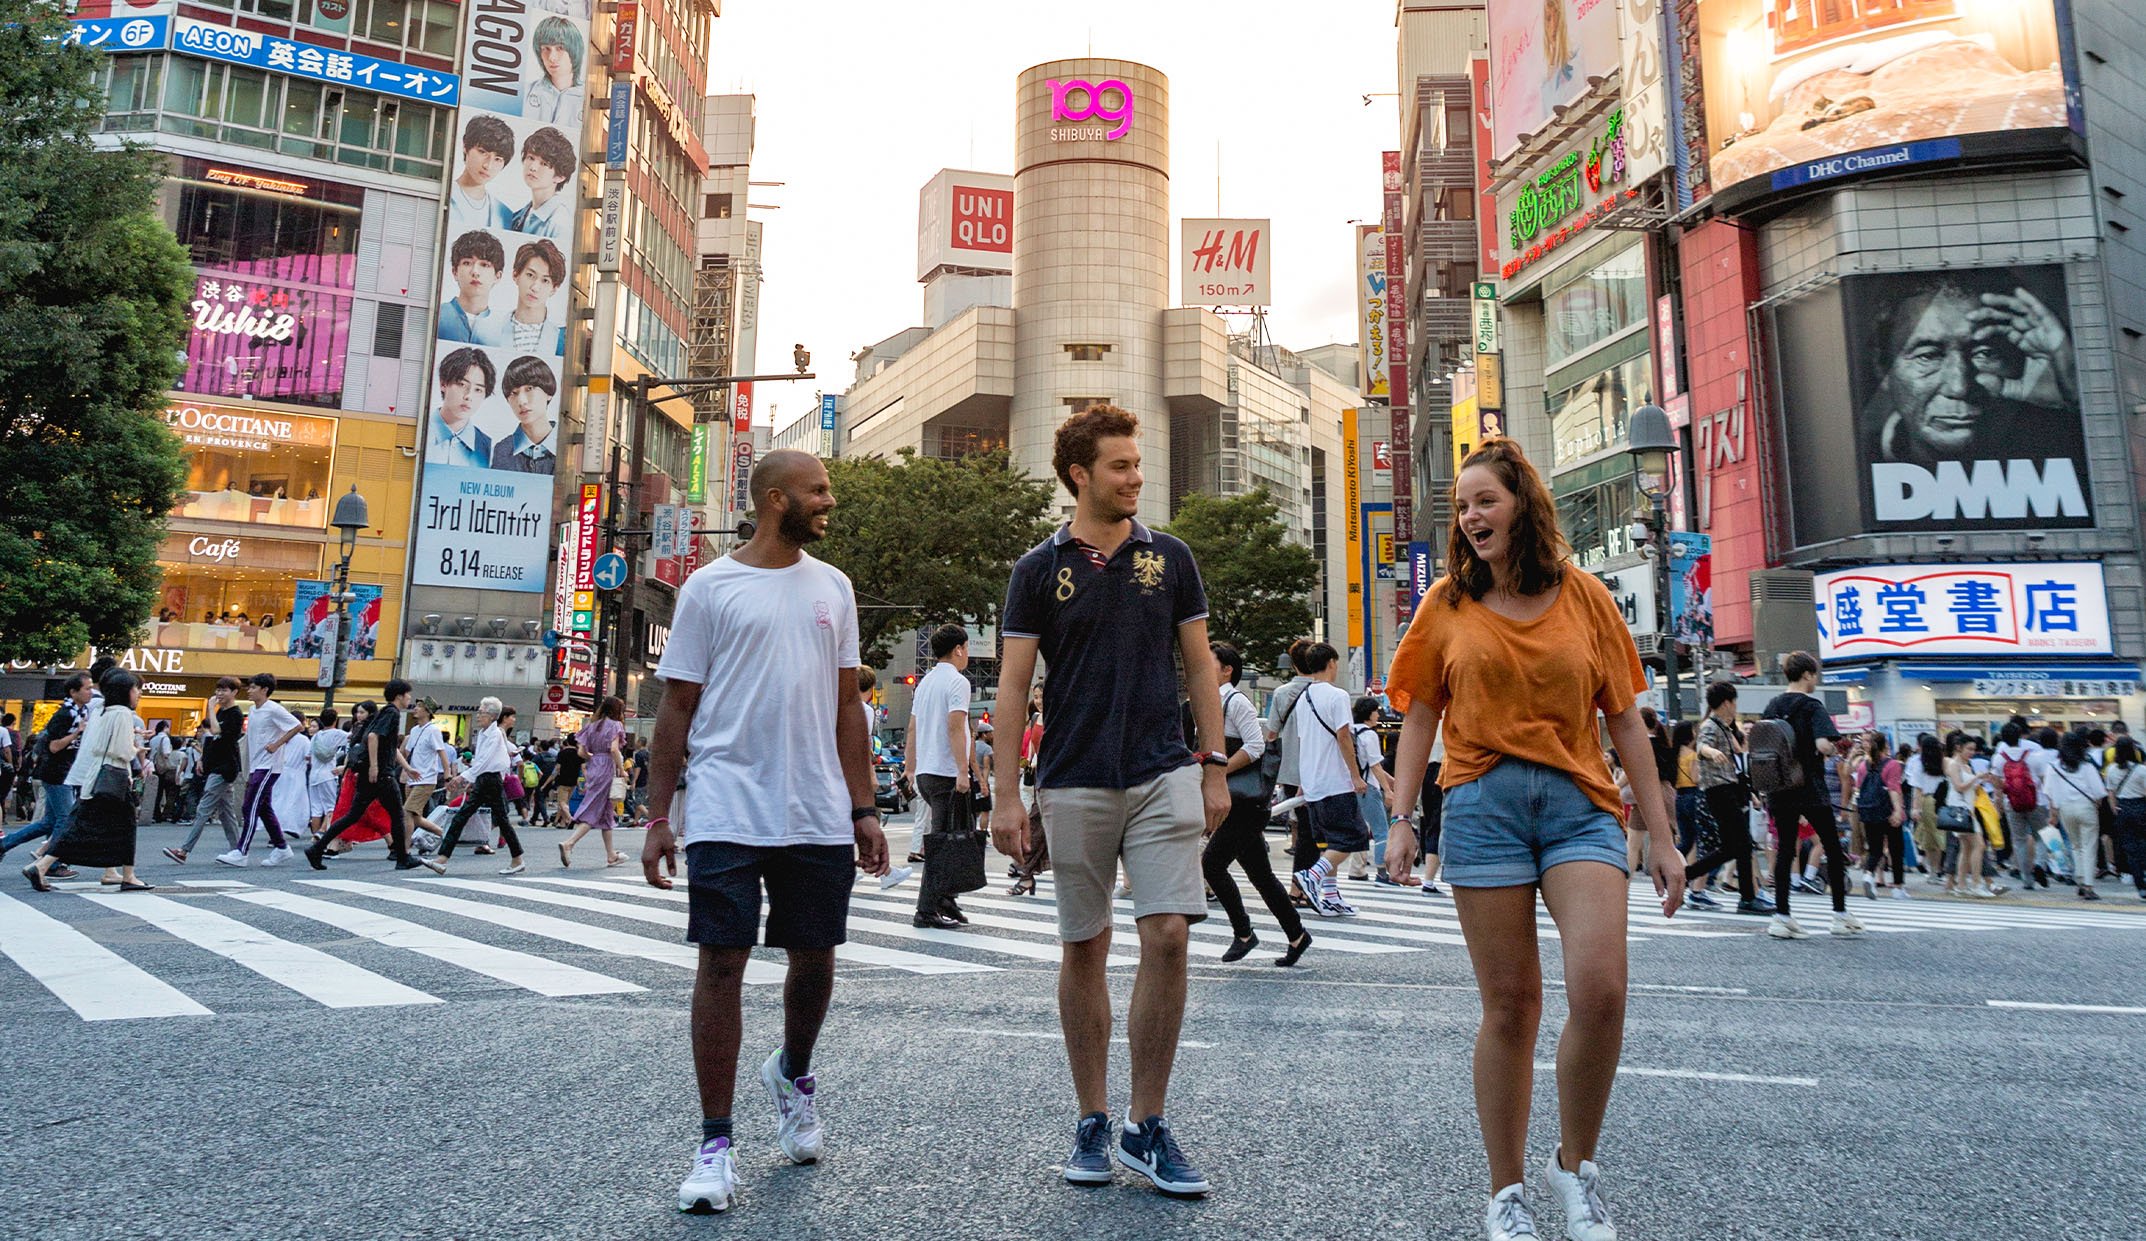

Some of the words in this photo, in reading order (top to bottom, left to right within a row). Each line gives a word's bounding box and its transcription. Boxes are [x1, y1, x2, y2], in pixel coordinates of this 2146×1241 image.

[125, 26, 151, 41] 6F
[185, 26, 250, 55] AEON
[618, 22, 634, 62] ガスト
[268, 40, 453, 97] 英会話イーオン
[1046, 79, 1134, 140] 109
[1050, 128, 1103, 142] SHIBUYA
[1808, 161, 1844, 179] DHC
[1847, 148, 1910, 171] Channel
[959, 194, 1003, 220] UNI
[603, 188, 619, 264] 渋谷駅前ビル
[958, 220, 1008, 246] QLO
[1192, 228, 1261, 274] H&M
[202, 281, 245, 303] 渋谷
[191, 299, 295, 342] Ushi8
[737, 393, 749, 420] 免税
[186, 434, 203, 444] EN
[206, 437, 269, 451] PROVENCE
[692, 427, 703, 456] レイク
[737, 442, 752, 468] OS
[1556, 419, 1626, 461] Euphoria
[690, 456, 702, 493] ALSA
[1347, 439, 1356, 479] KiYoshi
[460, 481, 482, 496] NEW
[483, 484, 515, 499] ALBUM
[1872, 458, 2089, 521] DMM
[426, 495, 463, 532] 3rd
[1350, 480, 1358, 542] Matsumoto
[661, 508, 674, 555] 渋谷駅前
[189, 537, 241, 562] Café
[440, 547, 481, 578] 8.14
[483, 564, 524, 581] RELEASE
[578, 513, 597, 585] サンドラッグ
[1055, 567, 1076, 601] 8
[1417, 553, 1427, 597] MIZUHO
[648, 623, 672, 657] LUS
[1989, 671, 2050, 681] TAISEIDO
